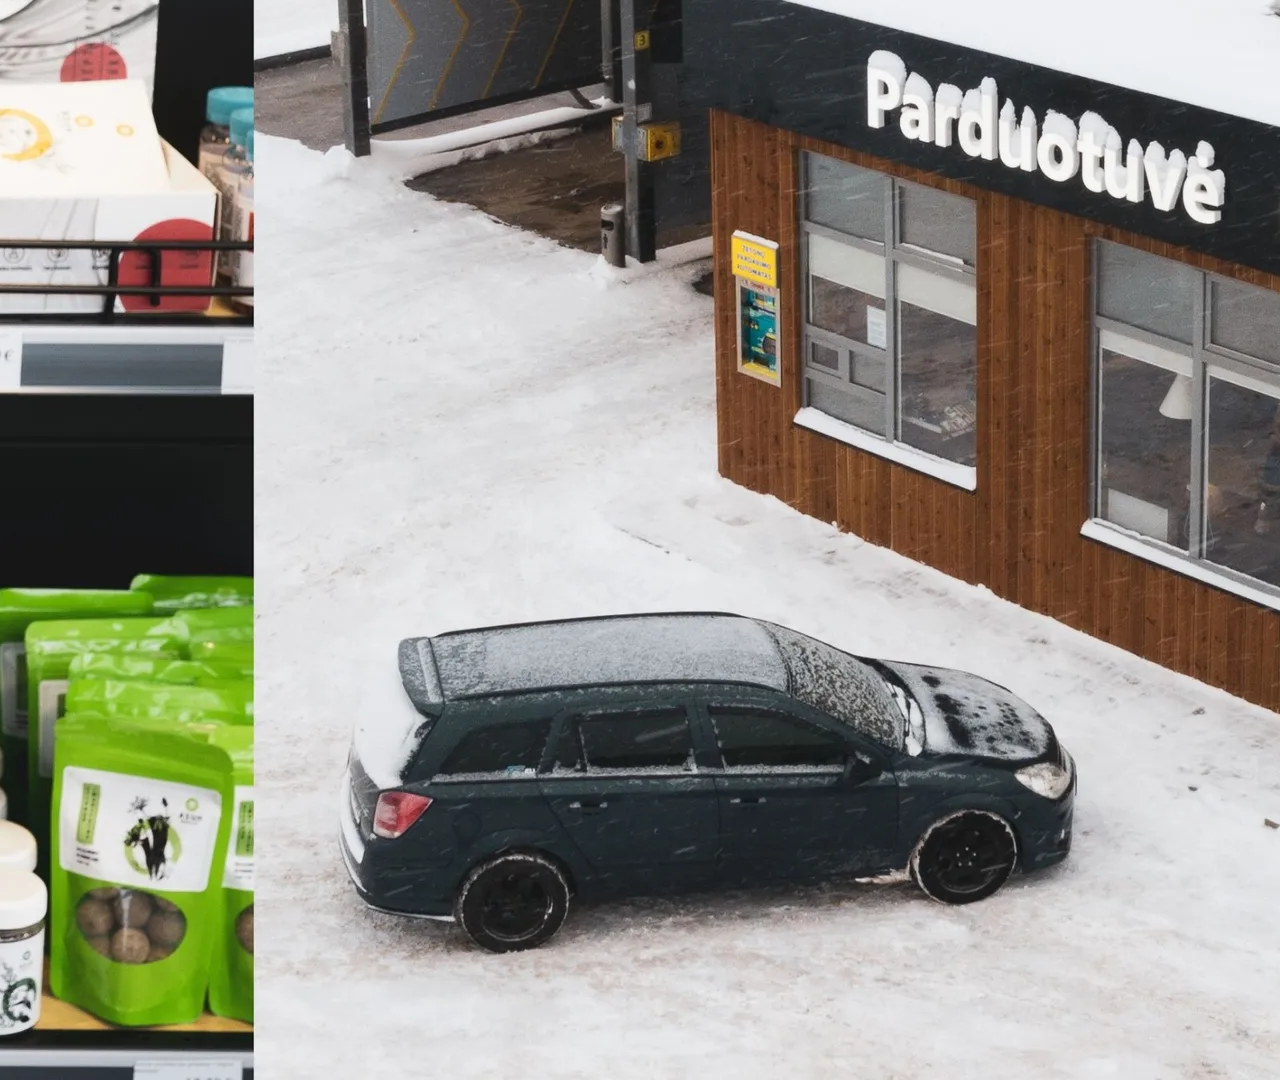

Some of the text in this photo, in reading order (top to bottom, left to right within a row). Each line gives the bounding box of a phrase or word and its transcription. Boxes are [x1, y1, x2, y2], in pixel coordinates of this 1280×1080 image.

[639, 35, 646, 45] 3
[867, 51, 1225, 224] Parduotuvė
[4, 349, 14, 362] €
